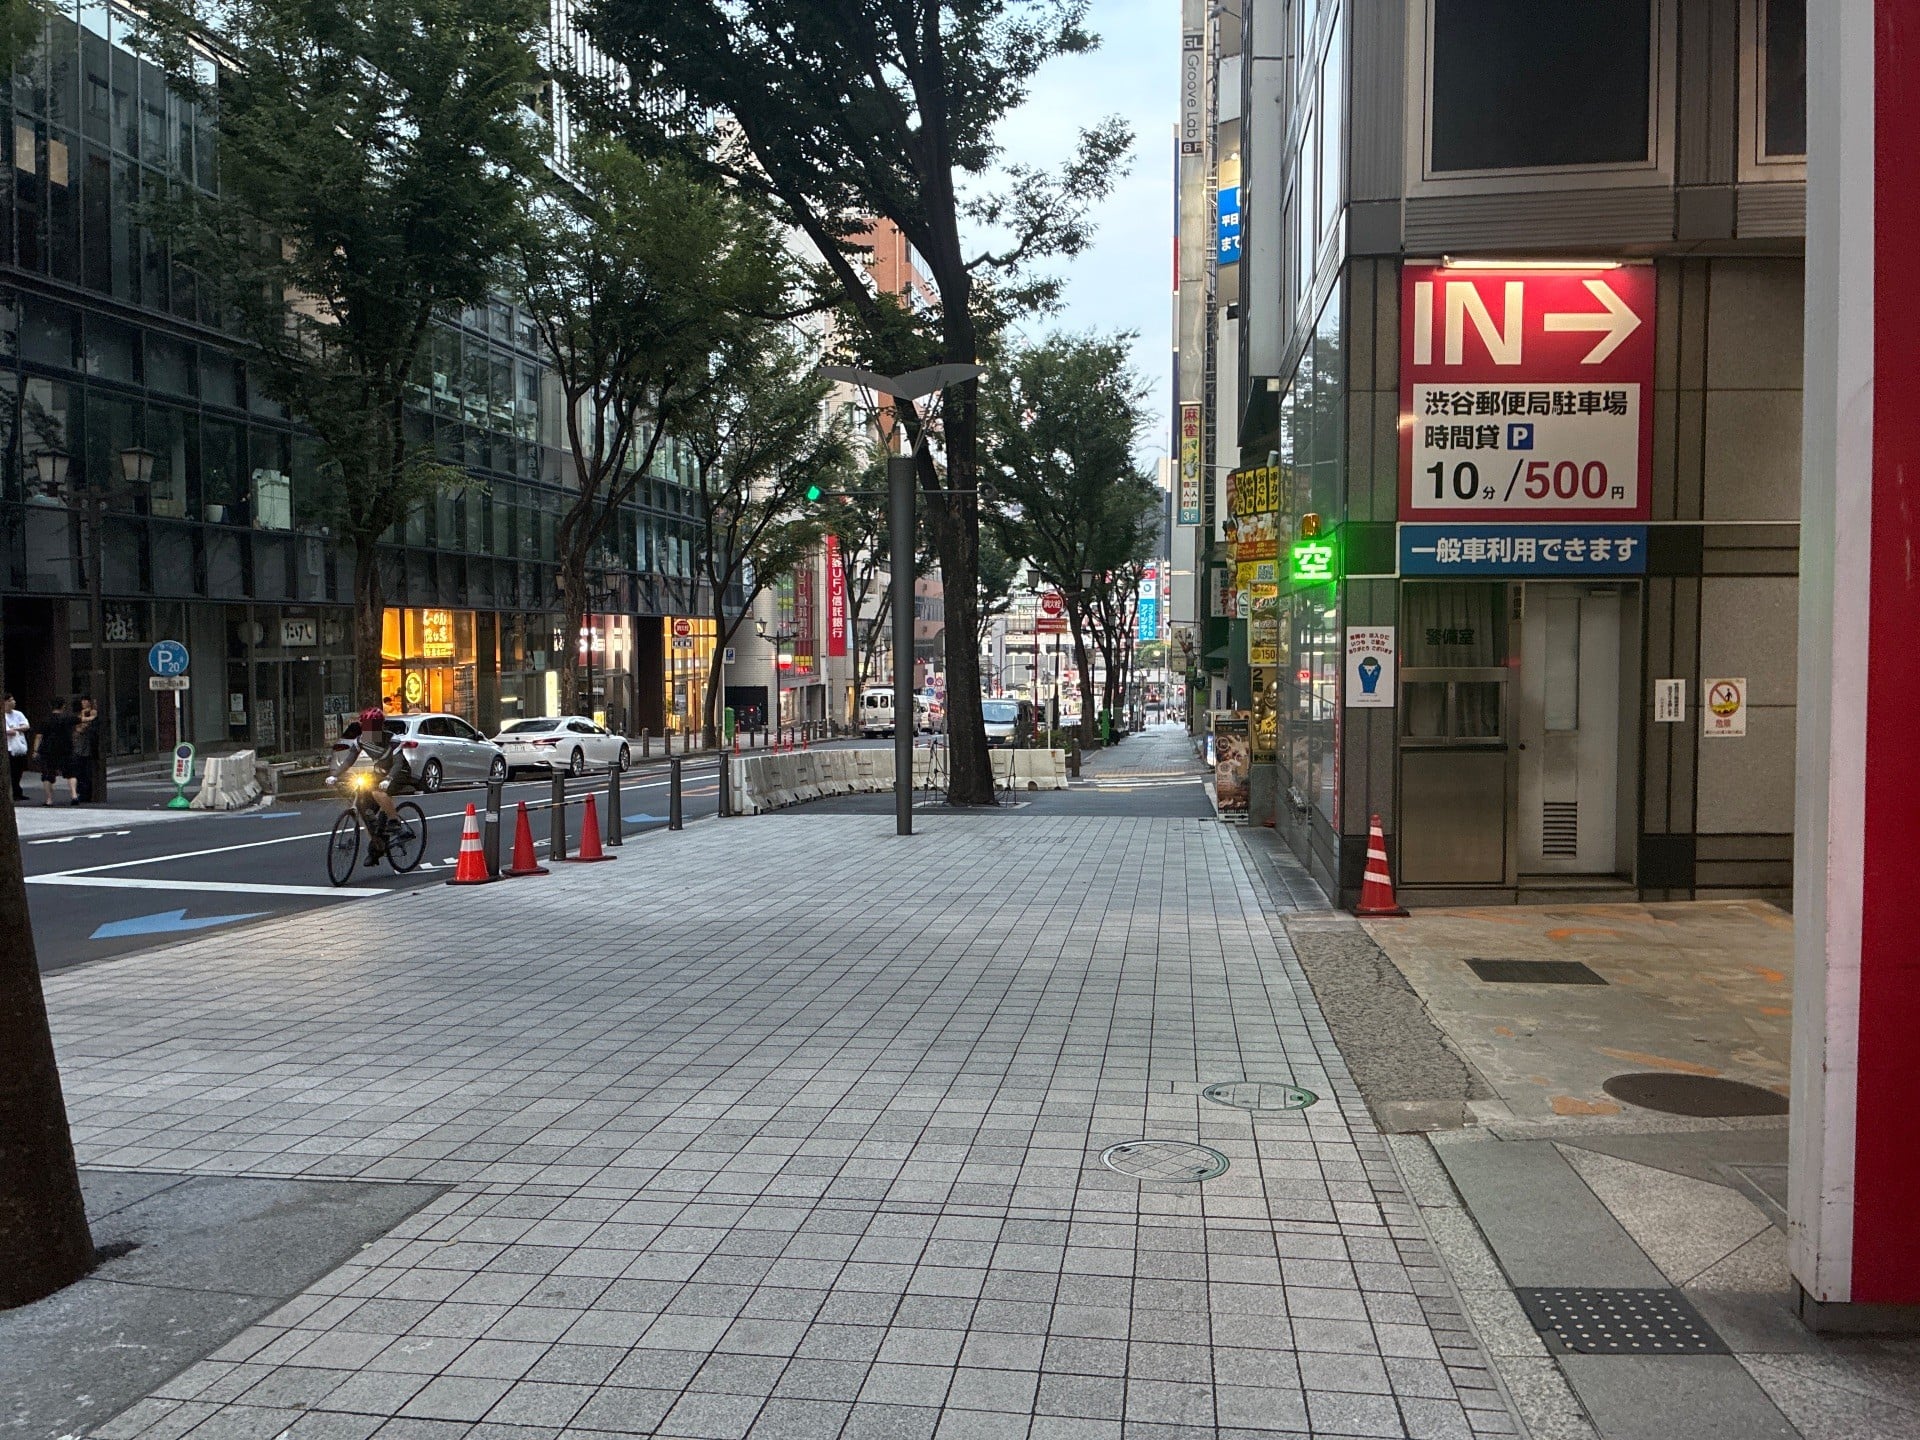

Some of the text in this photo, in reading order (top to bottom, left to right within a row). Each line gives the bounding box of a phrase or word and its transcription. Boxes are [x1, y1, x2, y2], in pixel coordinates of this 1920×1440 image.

[1187, 54, 1199, 138] Groove Lab
[1413, 281, 1524, 365] IN
[1424, 391, 1628, 416] 渋谷郵便局駐車場
[1184, 408, 1198, 437] 麻雀
[1424, 424, 1500, 450] 時間貸
[1257, 475, 1266, 506] おでん
[1270, 472, 1278, 505] 串カツ
[1293, 543, 1333, 580] 空
[1411, 537, 1638, 563] 一般車利用できます
